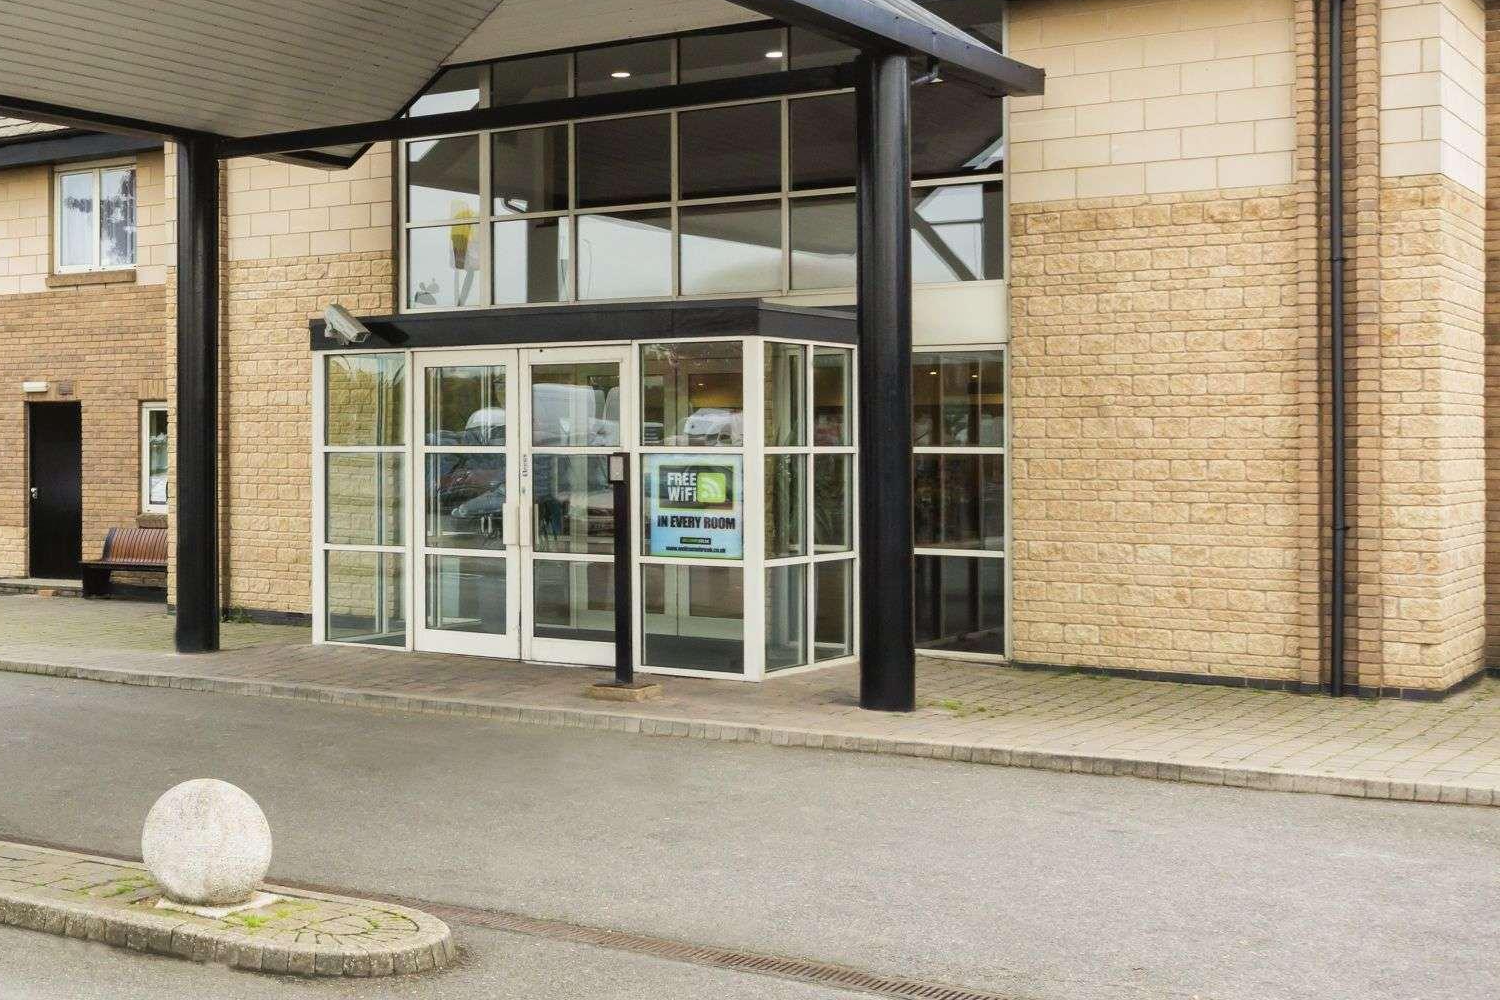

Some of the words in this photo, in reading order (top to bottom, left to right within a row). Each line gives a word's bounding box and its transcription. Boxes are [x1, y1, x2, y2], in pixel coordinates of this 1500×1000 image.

[667, 472, 697, 486] FREE
[657, 515, 668, 527] IN
[670, 516, 702, 528] EVERY
[703, 516, 735, 529] ROOM
